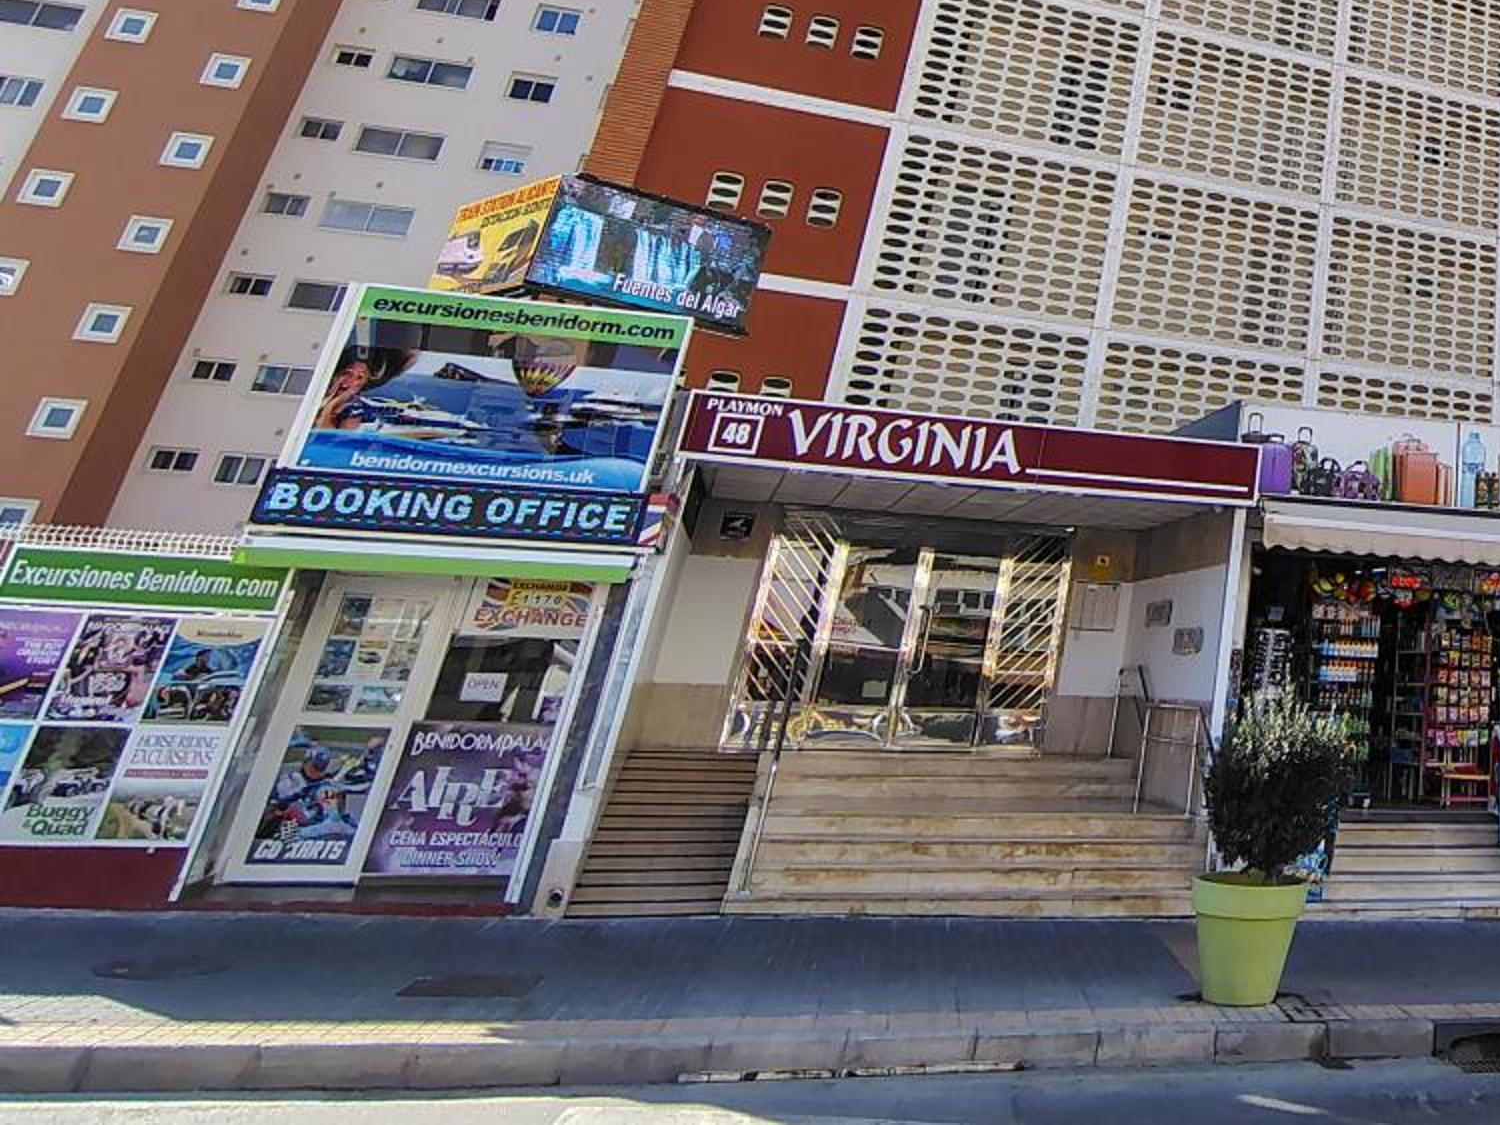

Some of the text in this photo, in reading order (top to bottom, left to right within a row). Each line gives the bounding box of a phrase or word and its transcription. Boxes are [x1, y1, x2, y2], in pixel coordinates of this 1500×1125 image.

[613, 274, 743, 319] Fuentes del Algar
[373, 297, 675, 341] excursionesbenidorm.com
[707, 398, 784, 416] PLAYMON
[721, 421, 751, 446] 48
[787, 408, 1021, 475] VIRGINIA
[350, 451, 596, 484] benidormexcursions.uk
[269, 482, 632, 532] BOOKING OFFICE
[9, 560, 279, 598] Excursiones Benidorm.com
[473, 608, 589, 628] EXCHANGE
[467, 679, 499, 691] OPEN
[26, 803, 96, 822] Buggy
[31, 819, 87, 837] Quad
[390, 830, 427, 847] CENA
[253, 839, 281, 860] GO
